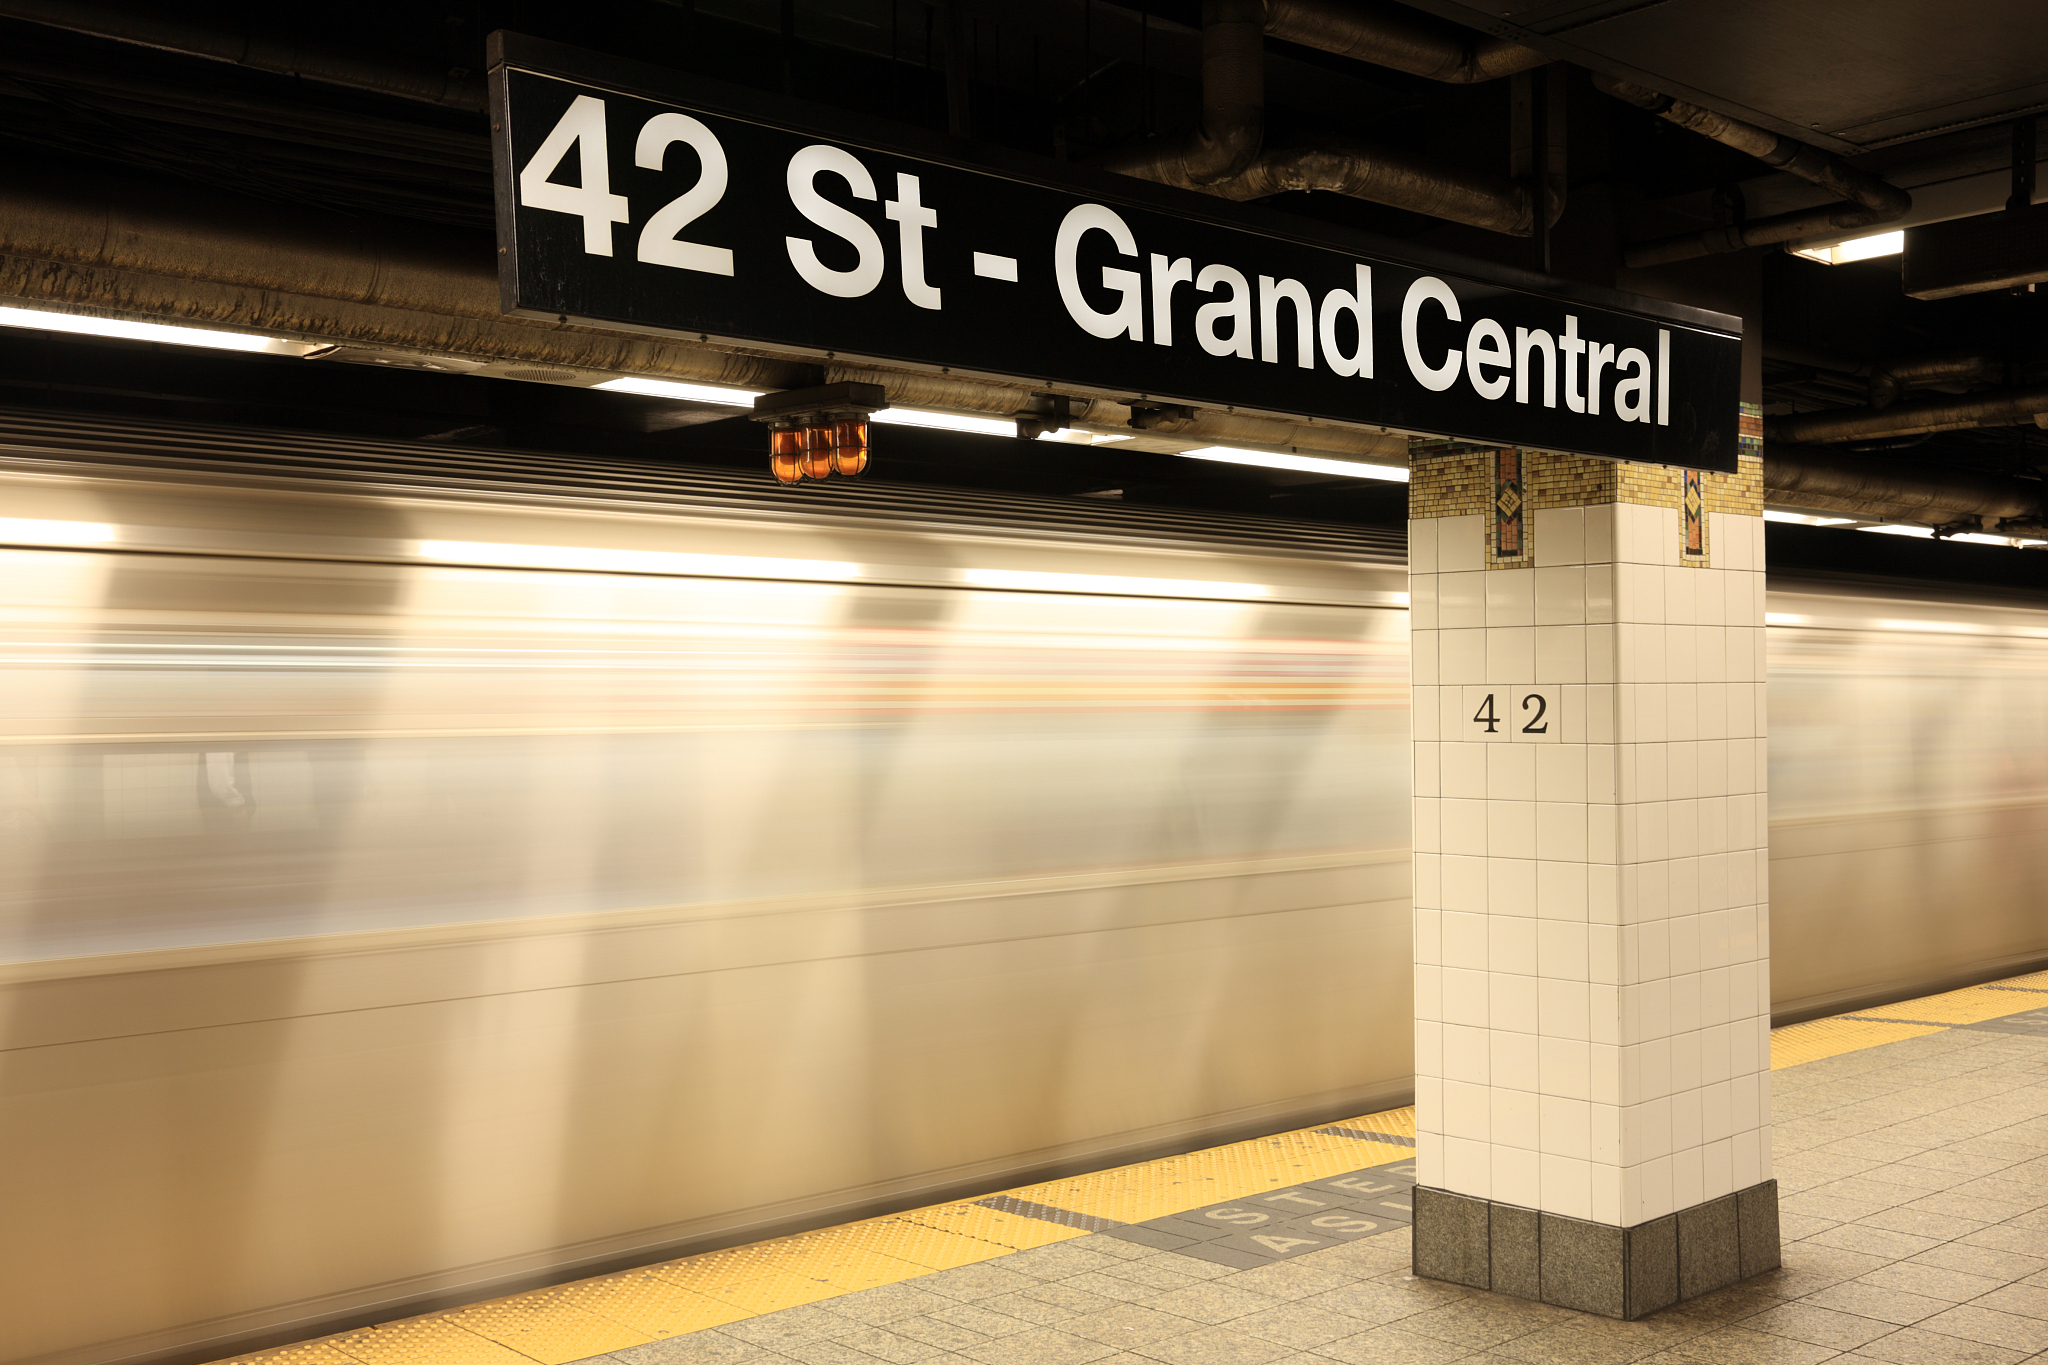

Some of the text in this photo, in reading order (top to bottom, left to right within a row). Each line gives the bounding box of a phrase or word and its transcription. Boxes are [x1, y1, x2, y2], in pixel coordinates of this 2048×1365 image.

[519, 95, 735, 277] 42
[785, 145, 942, 311] St
[1054, 204, 1374, 380] Grand
[1401, 276, 1671, 427] Central
